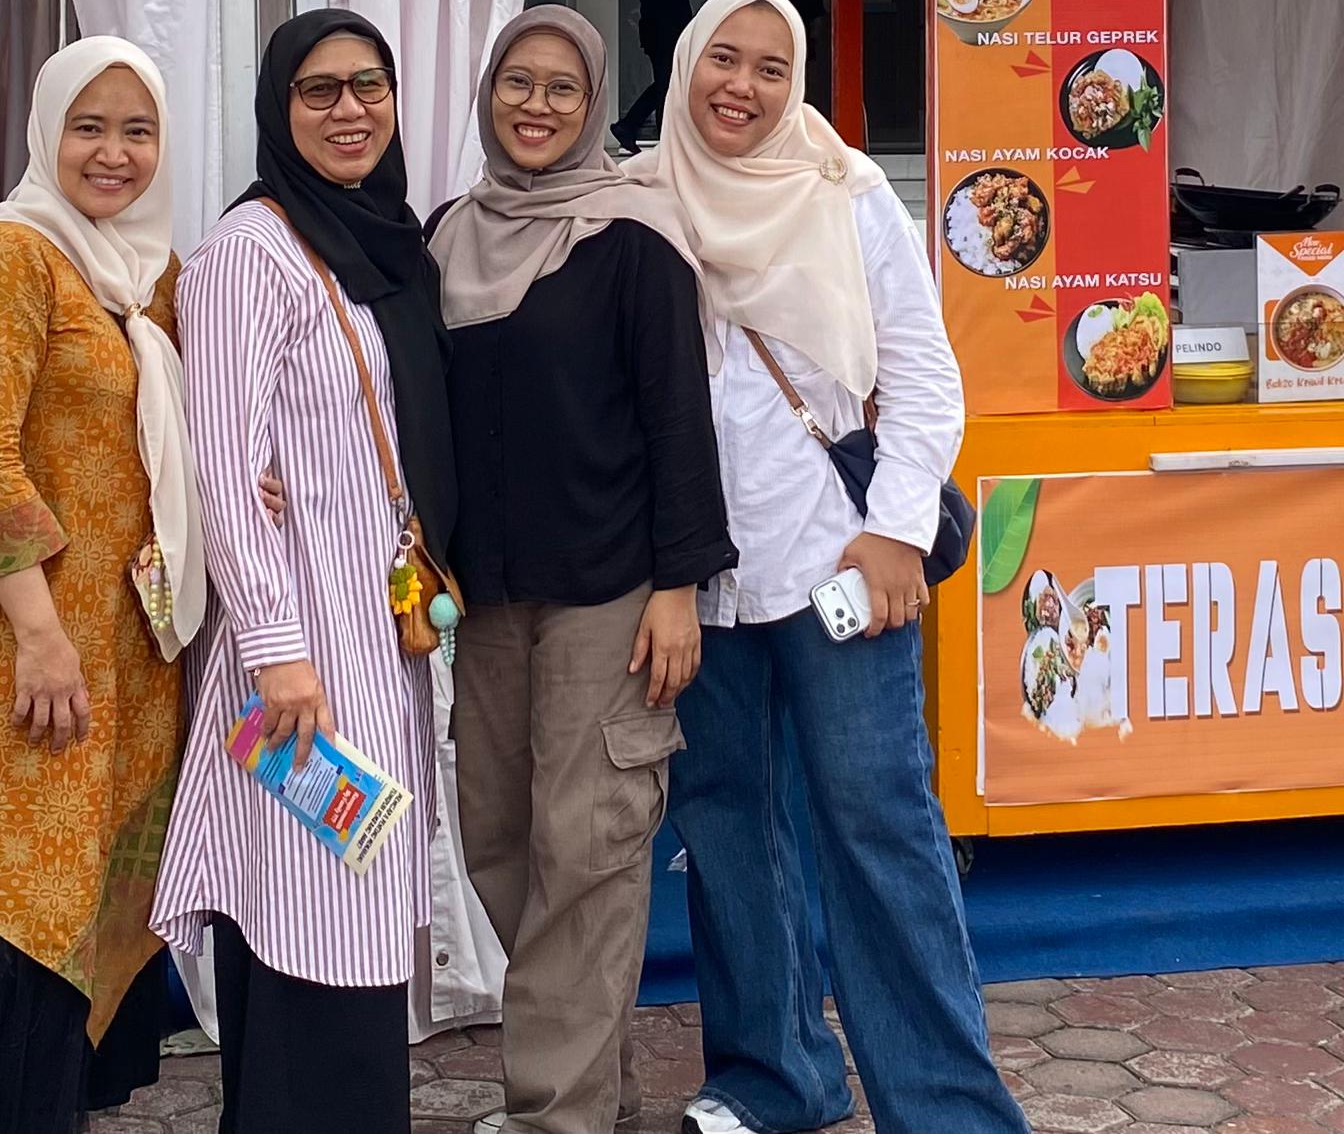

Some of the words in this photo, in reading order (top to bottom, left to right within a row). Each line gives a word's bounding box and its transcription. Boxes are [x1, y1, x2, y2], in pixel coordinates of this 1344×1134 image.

[977, 32, 1019, 46] NASI
[1024, 31, 1082, 45] TELUR
[1086, 30, 1159, 44] GEPREK
[945, 150, 987, 163] NASI
[992, 148, 1041, 162] AYAM
[1046, 146, 1110, 161] KOCAK
[1289, 242, 1334, 259] Special
[1005, 276, 1046, 290] NASI
[1052, 274, 1100, 289] AYAM
[1105, 273, 1162, 287] KATSU
[1176, 342, 1222, 353] PELINDO
[1093, 558, 1343, 719] TERAS
